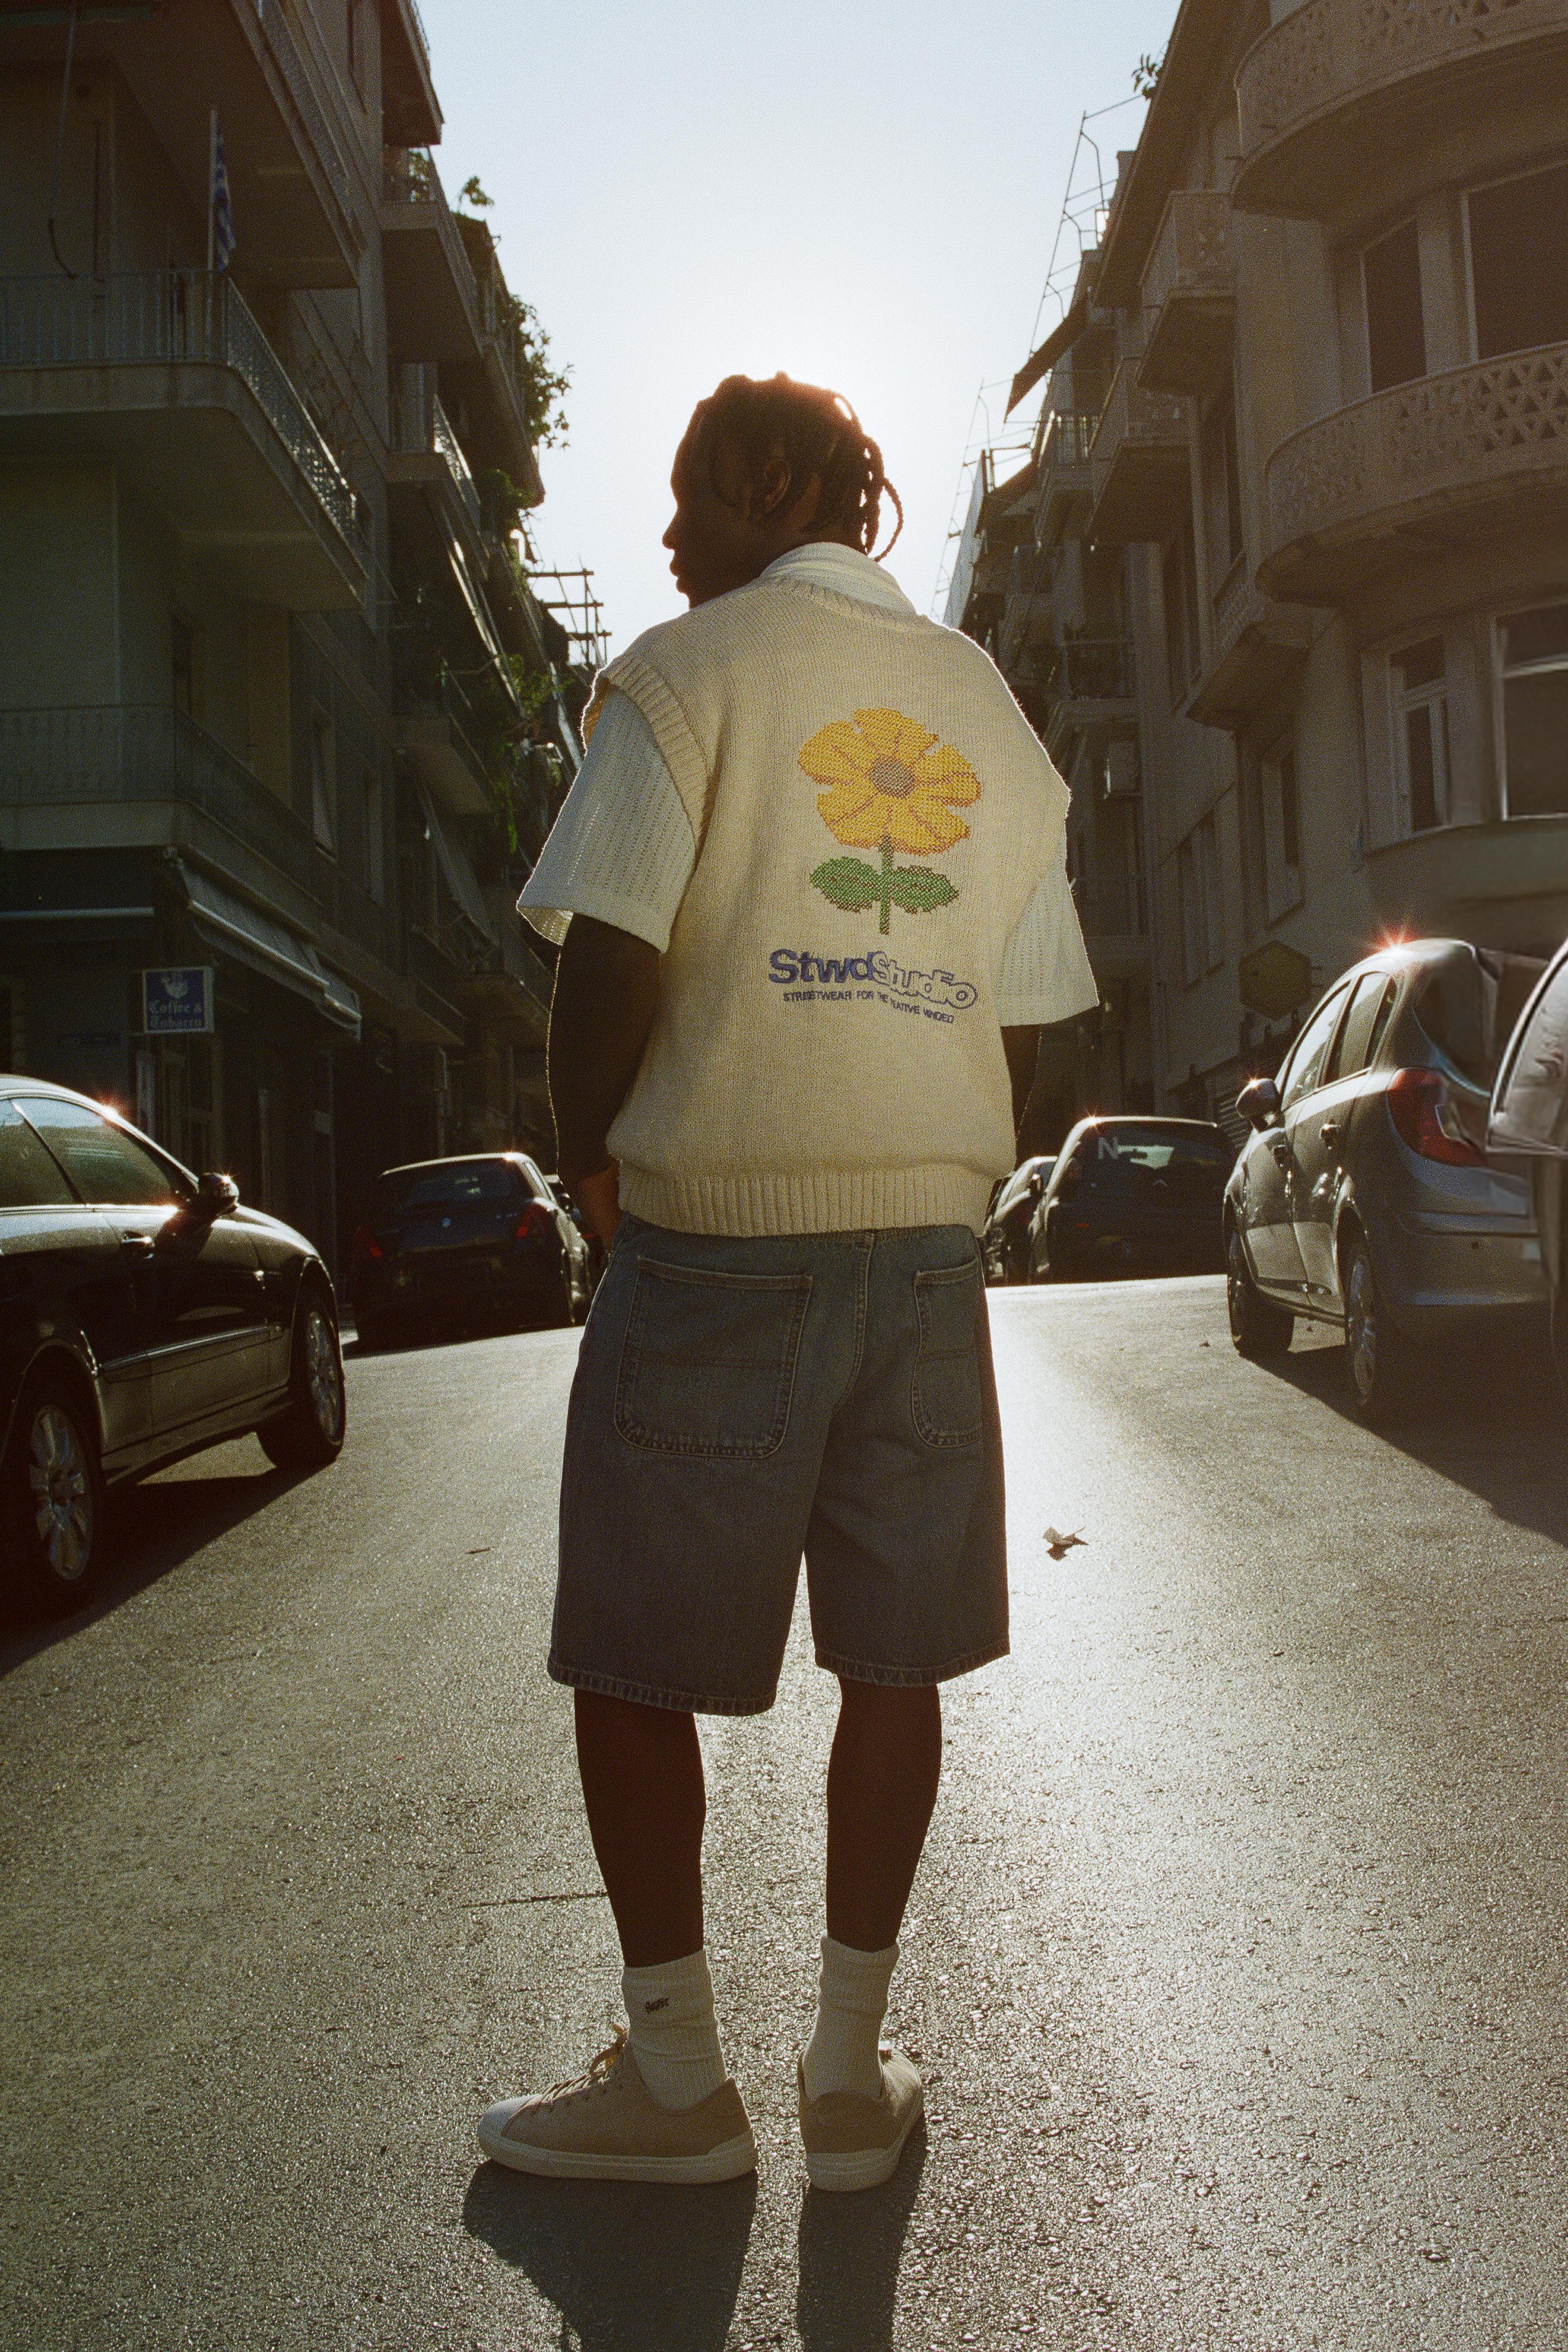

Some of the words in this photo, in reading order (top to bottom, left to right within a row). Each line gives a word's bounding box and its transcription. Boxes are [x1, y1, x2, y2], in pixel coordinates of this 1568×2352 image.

[783, 990, 852, 1002] STREETWEAR
[856, 990, 874, 1000] FOR
[1098, 1137, 1119, 1160] N
